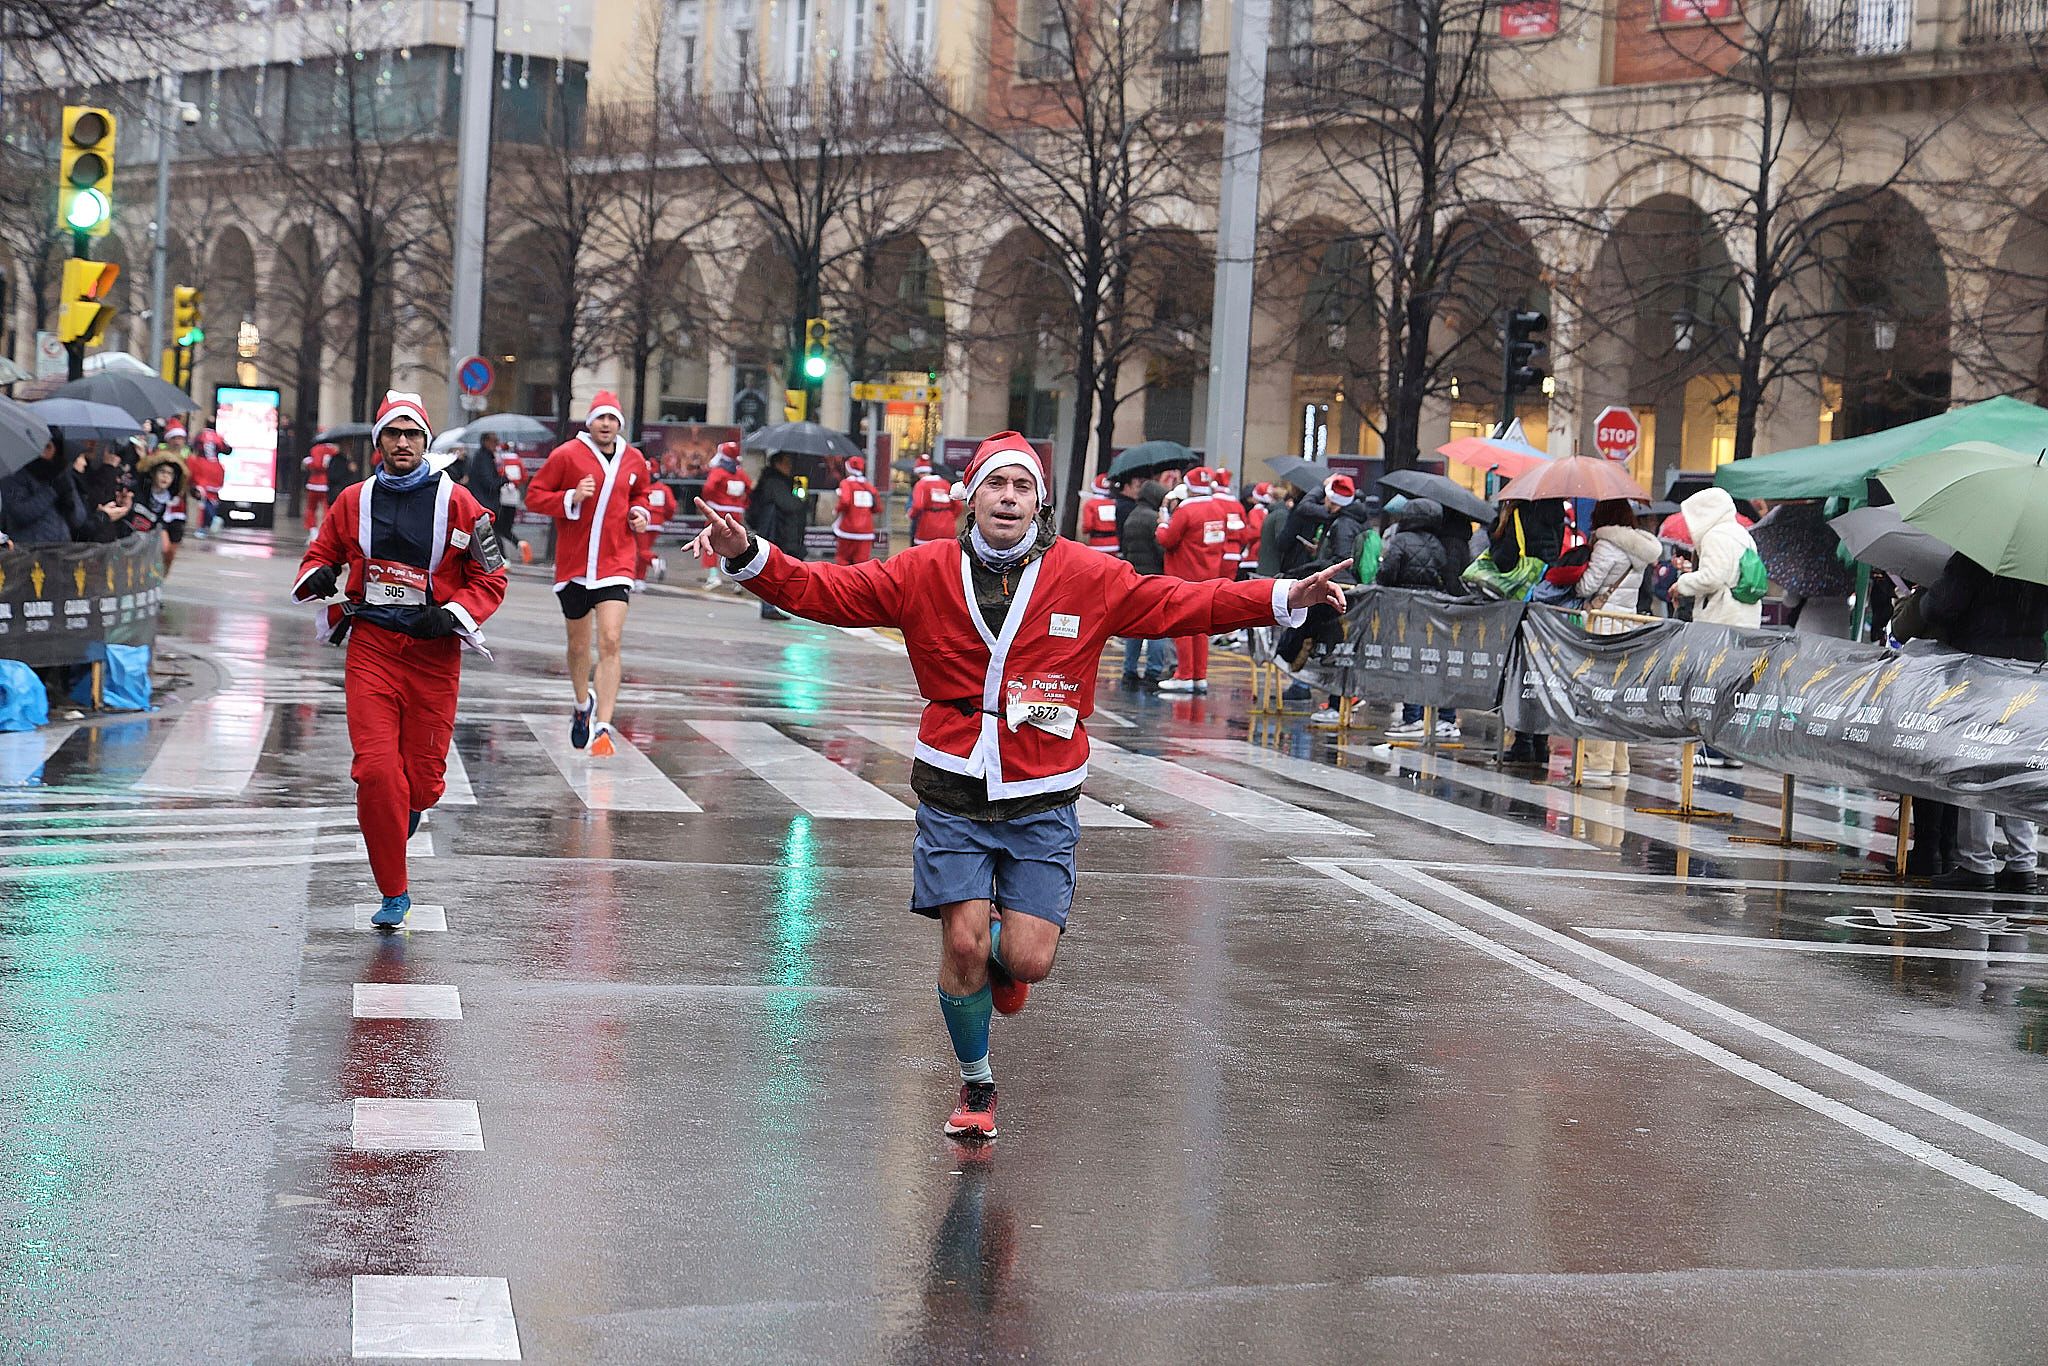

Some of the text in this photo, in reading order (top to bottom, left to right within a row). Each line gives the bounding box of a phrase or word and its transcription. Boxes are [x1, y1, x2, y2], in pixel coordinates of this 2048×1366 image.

[1600, 428, 1635, 443] STOP
[384, 585, 405, 598] 505
[1031, 680, 1079, 692] Papá Noel
